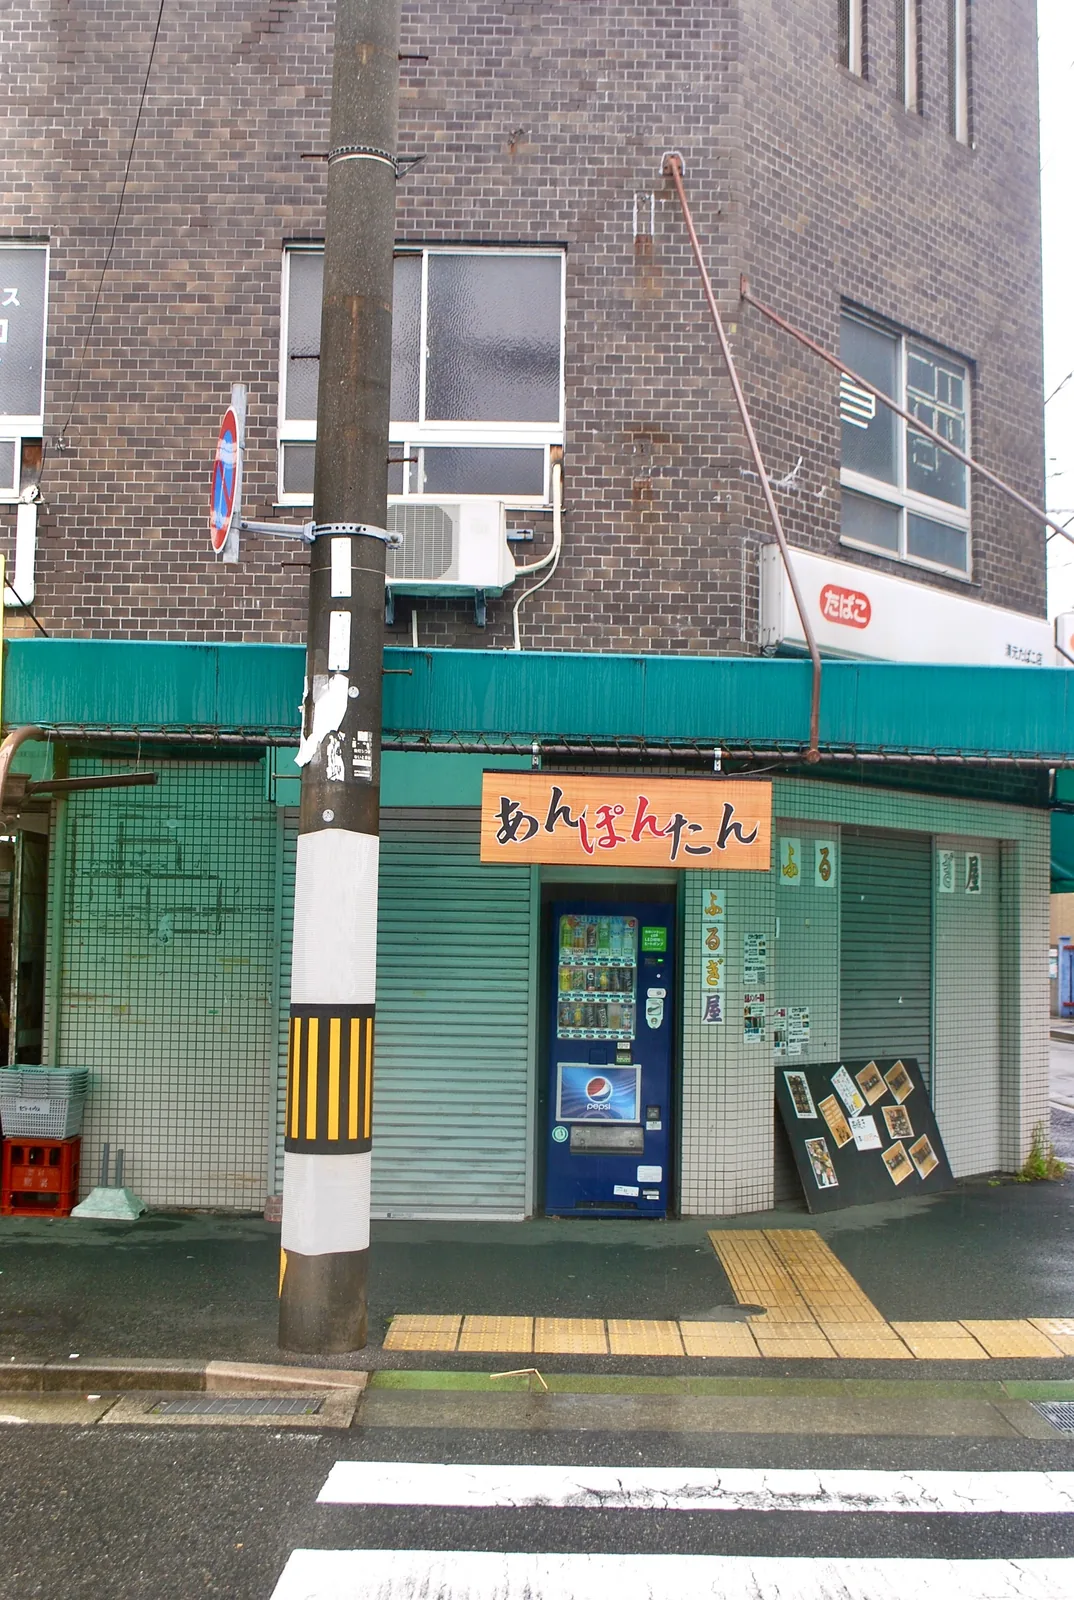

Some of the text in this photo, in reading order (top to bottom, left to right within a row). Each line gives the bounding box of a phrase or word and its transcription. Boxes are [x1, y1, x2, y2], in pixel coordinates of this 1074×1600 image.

[824, 589, 868, 624] たばこ
[495, 785, 759, 861] あんぽんたん
[703, 891, 723, 1023] ふるぎ屋
[586, 1102, 611, 1111] pepsi
